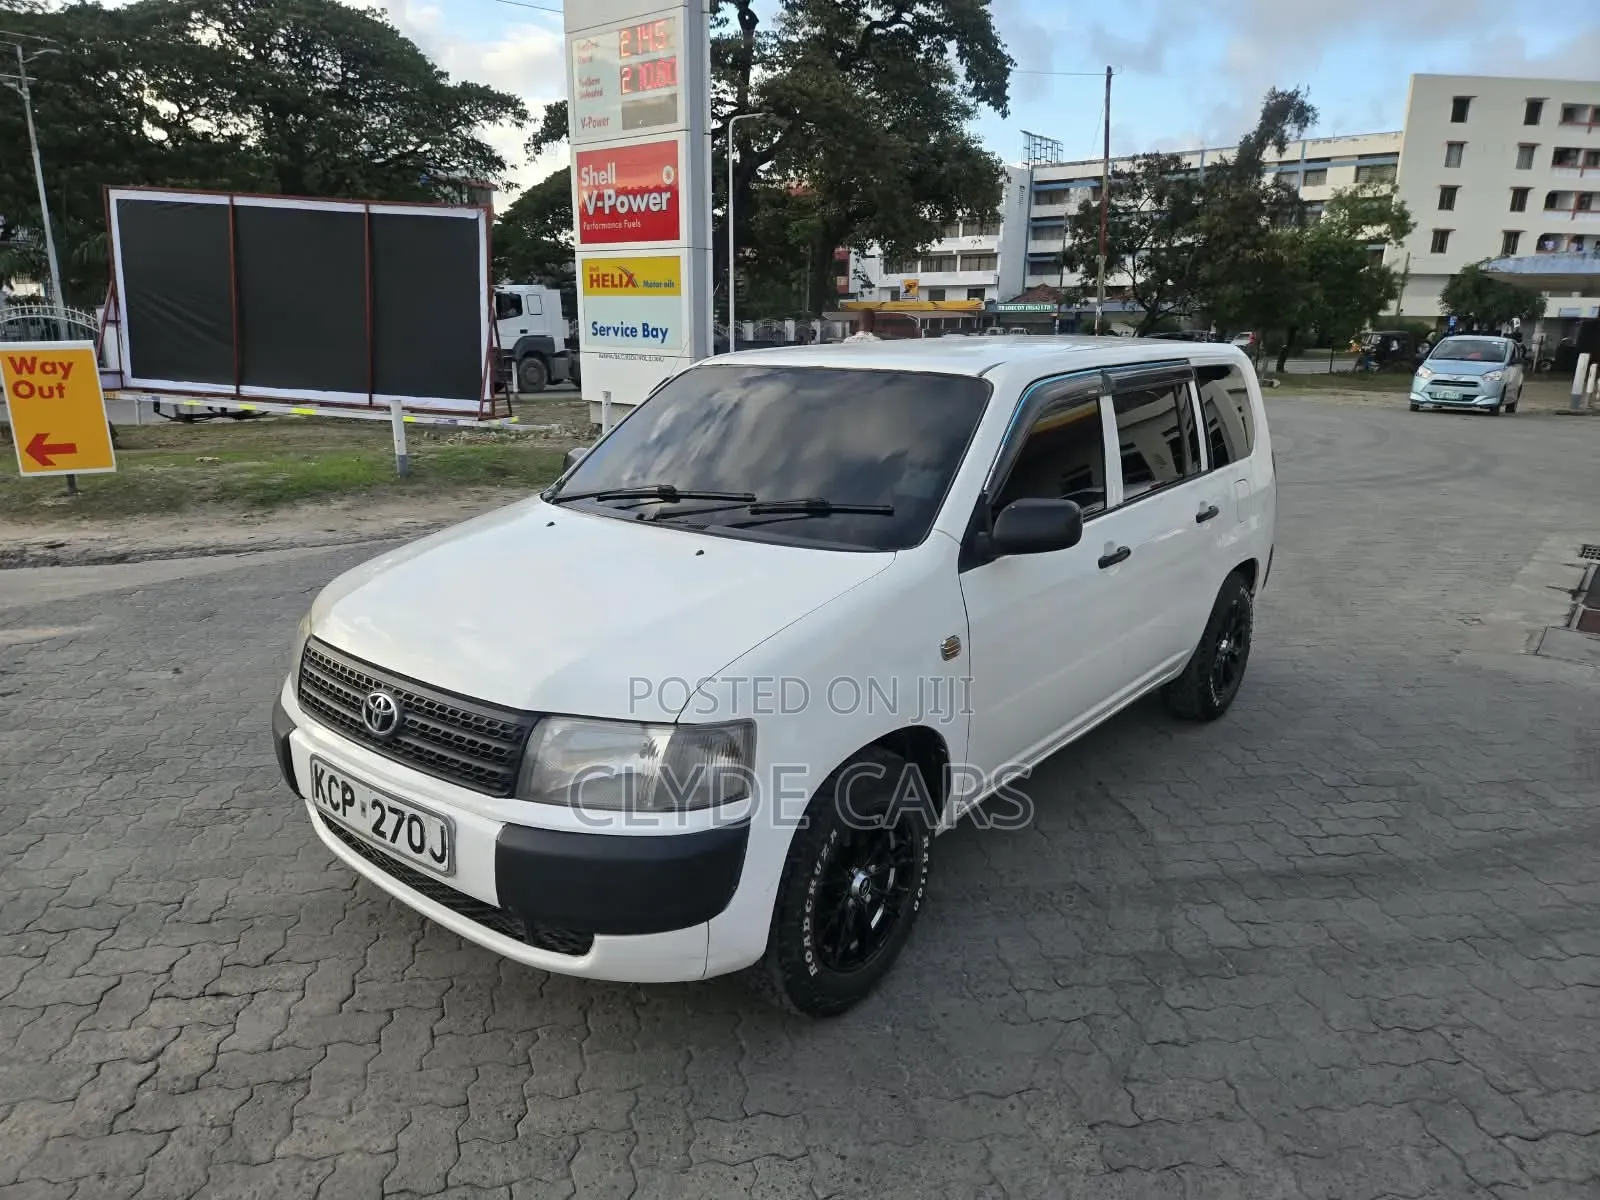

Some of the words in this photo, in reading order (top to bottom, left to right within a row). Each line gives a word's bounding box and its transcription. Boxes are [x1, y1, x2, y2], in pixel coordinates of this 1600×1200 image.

[581, 117, 609, 129] V-Power
[581, 162, 616, 186] Shell
[583, 189, 671, 216] V-Power
[583, 221, 622, 231] Performance
[623, 219, 641, 229] Fuels
[589, 273, 637, 289] HELIX
[643, 280, 662, 288] Motor
[591, 321, 638, 338] Service
[641, 322, 669, 344] Bay
[8, 356, 74, 380] Way
[12, 380, 66, 399] Out
[314, 763, 355, 818] KCP
[371, 798, 447, 864] 270J
